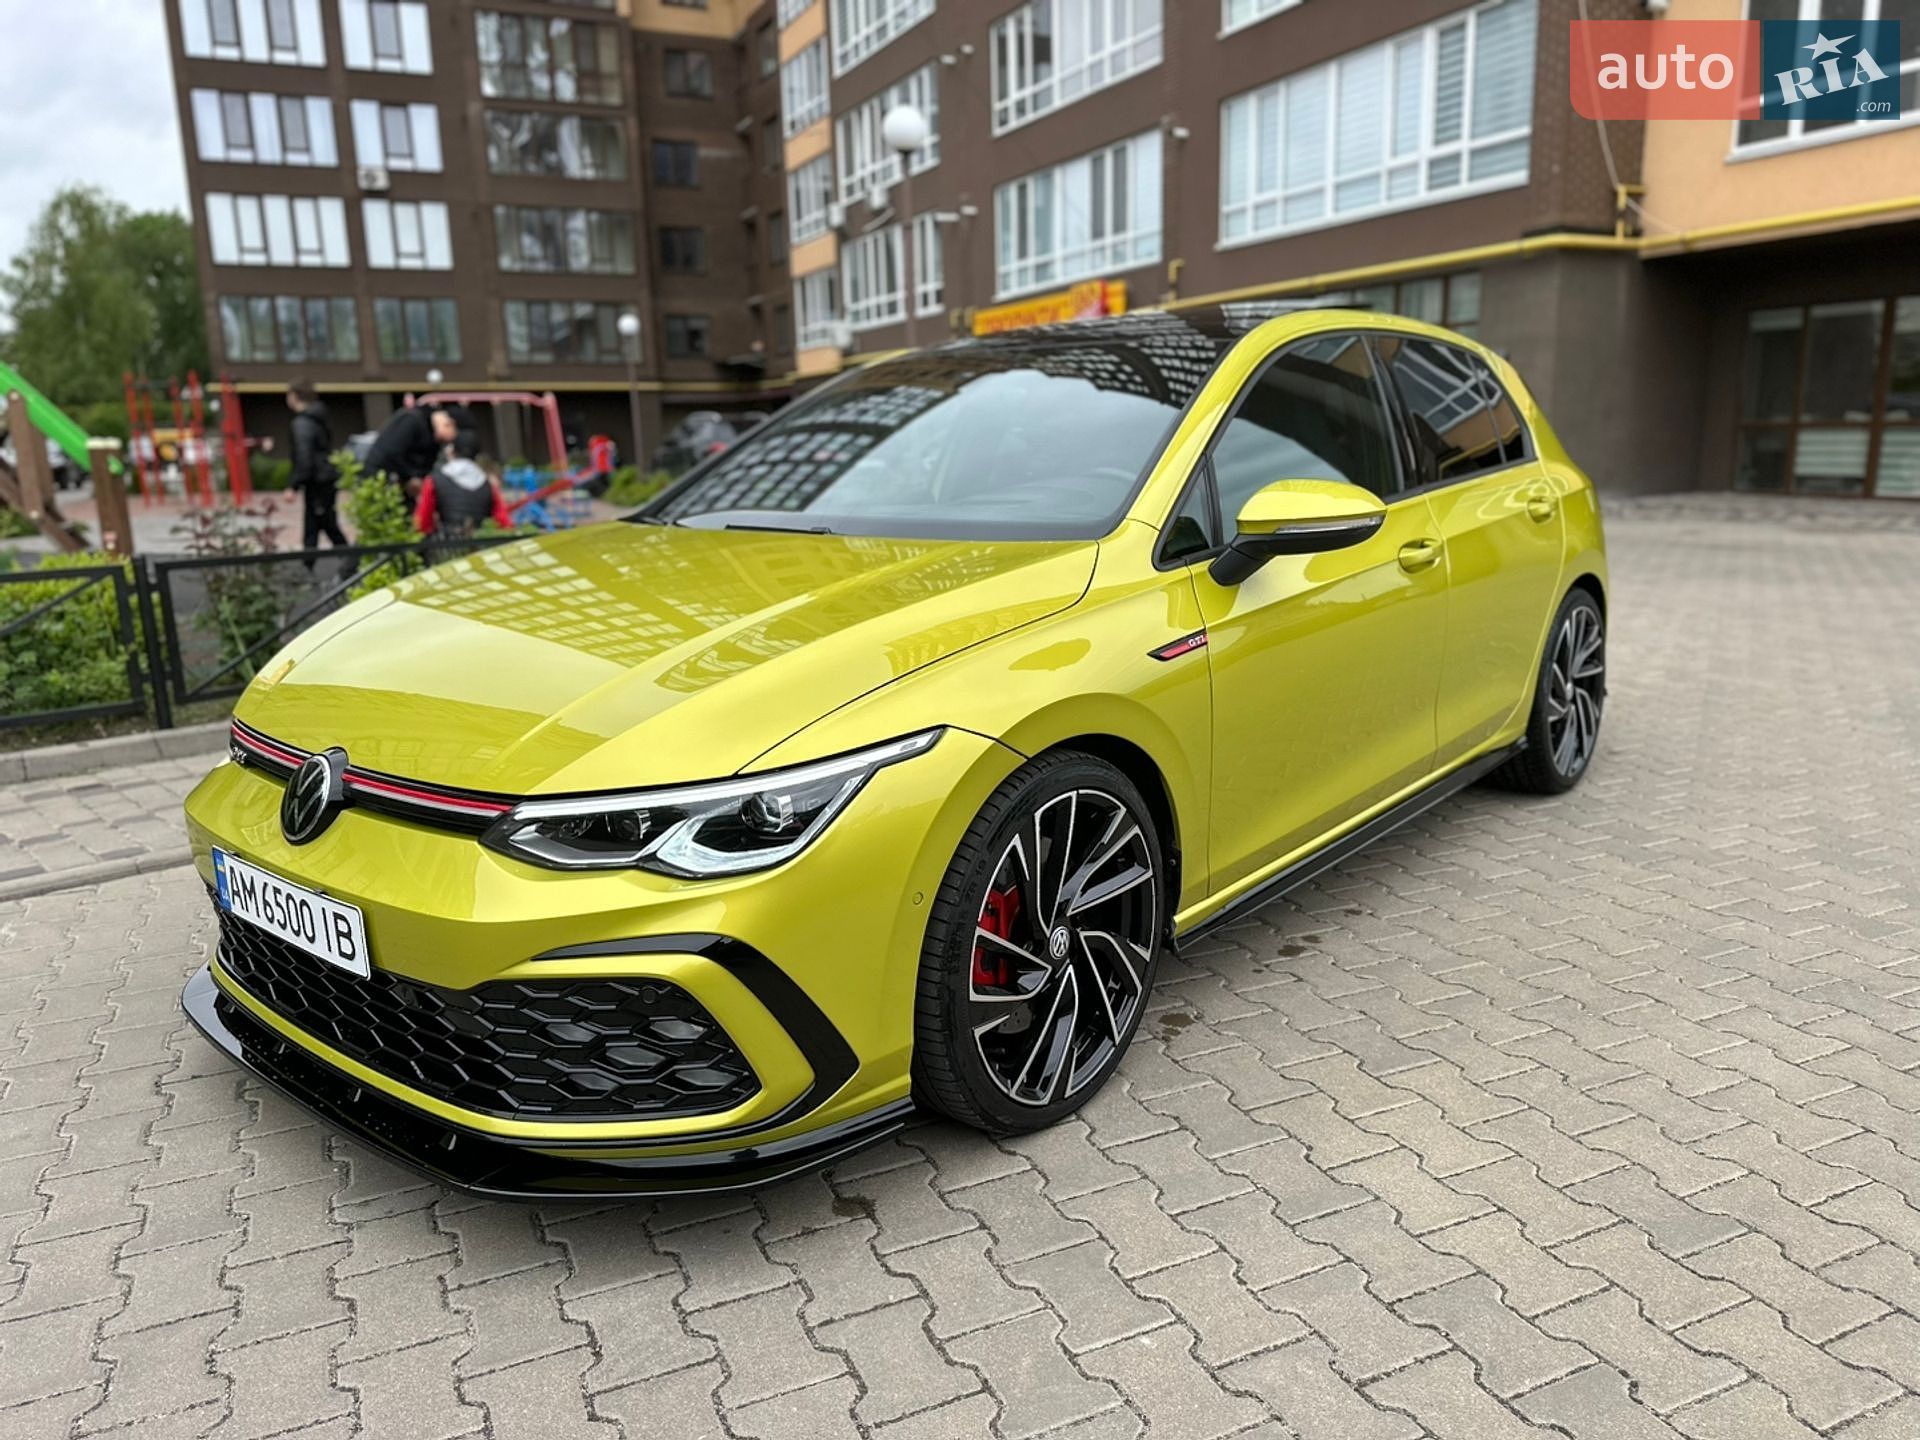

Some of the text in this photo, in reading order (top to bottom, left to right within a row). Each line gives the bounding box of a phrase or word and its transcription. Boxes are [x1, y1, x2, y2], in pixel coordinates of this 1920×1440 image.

[1188, 634, 1205, 647] GTI
[229, 865, 356, 961] AM 6500 IB
